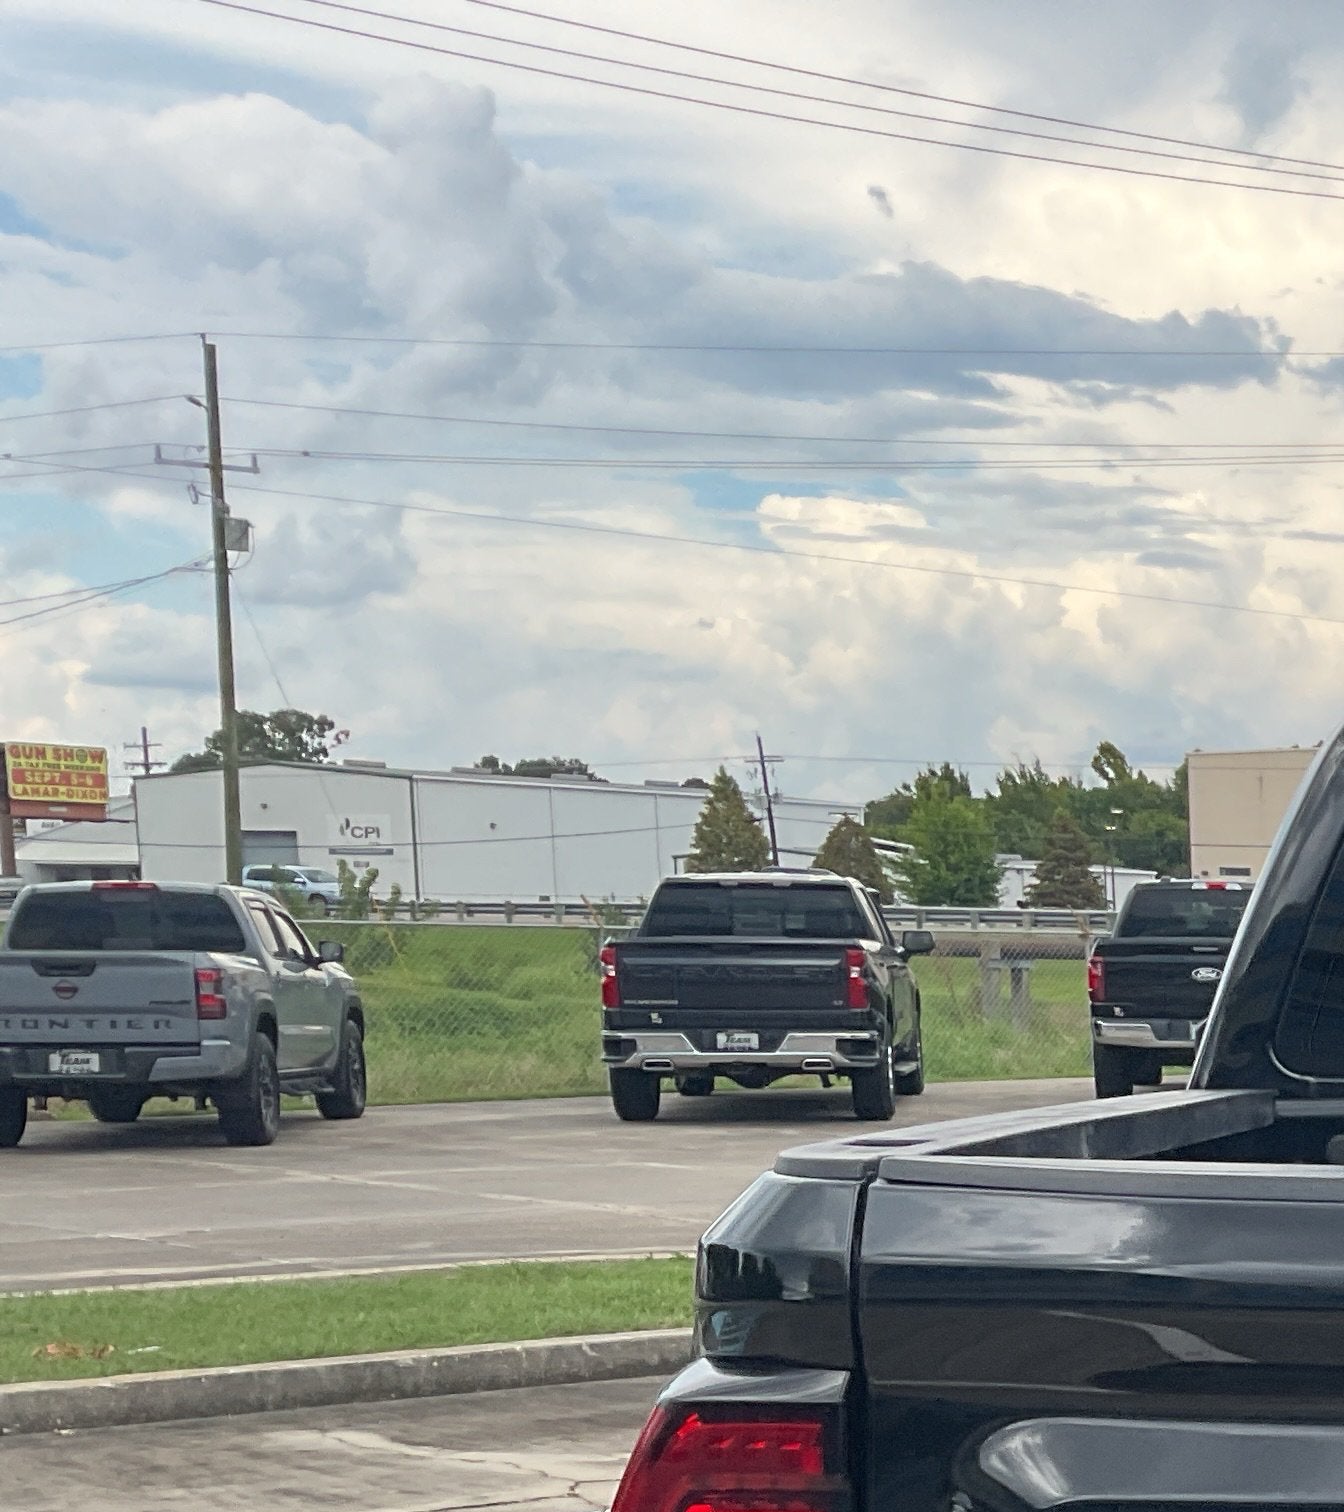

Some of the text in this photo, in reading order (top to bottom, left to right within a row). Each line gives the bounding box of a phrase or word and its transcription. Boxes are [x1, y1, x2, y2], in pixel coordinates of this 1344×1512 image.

[9, 744, 105, 764] GUN SHOW
[12, 786, 107, 800] LAMAR-DIXON
[350, 825, 381, 839] CPI
[0, 1018, 173, 1030] RONTIER
